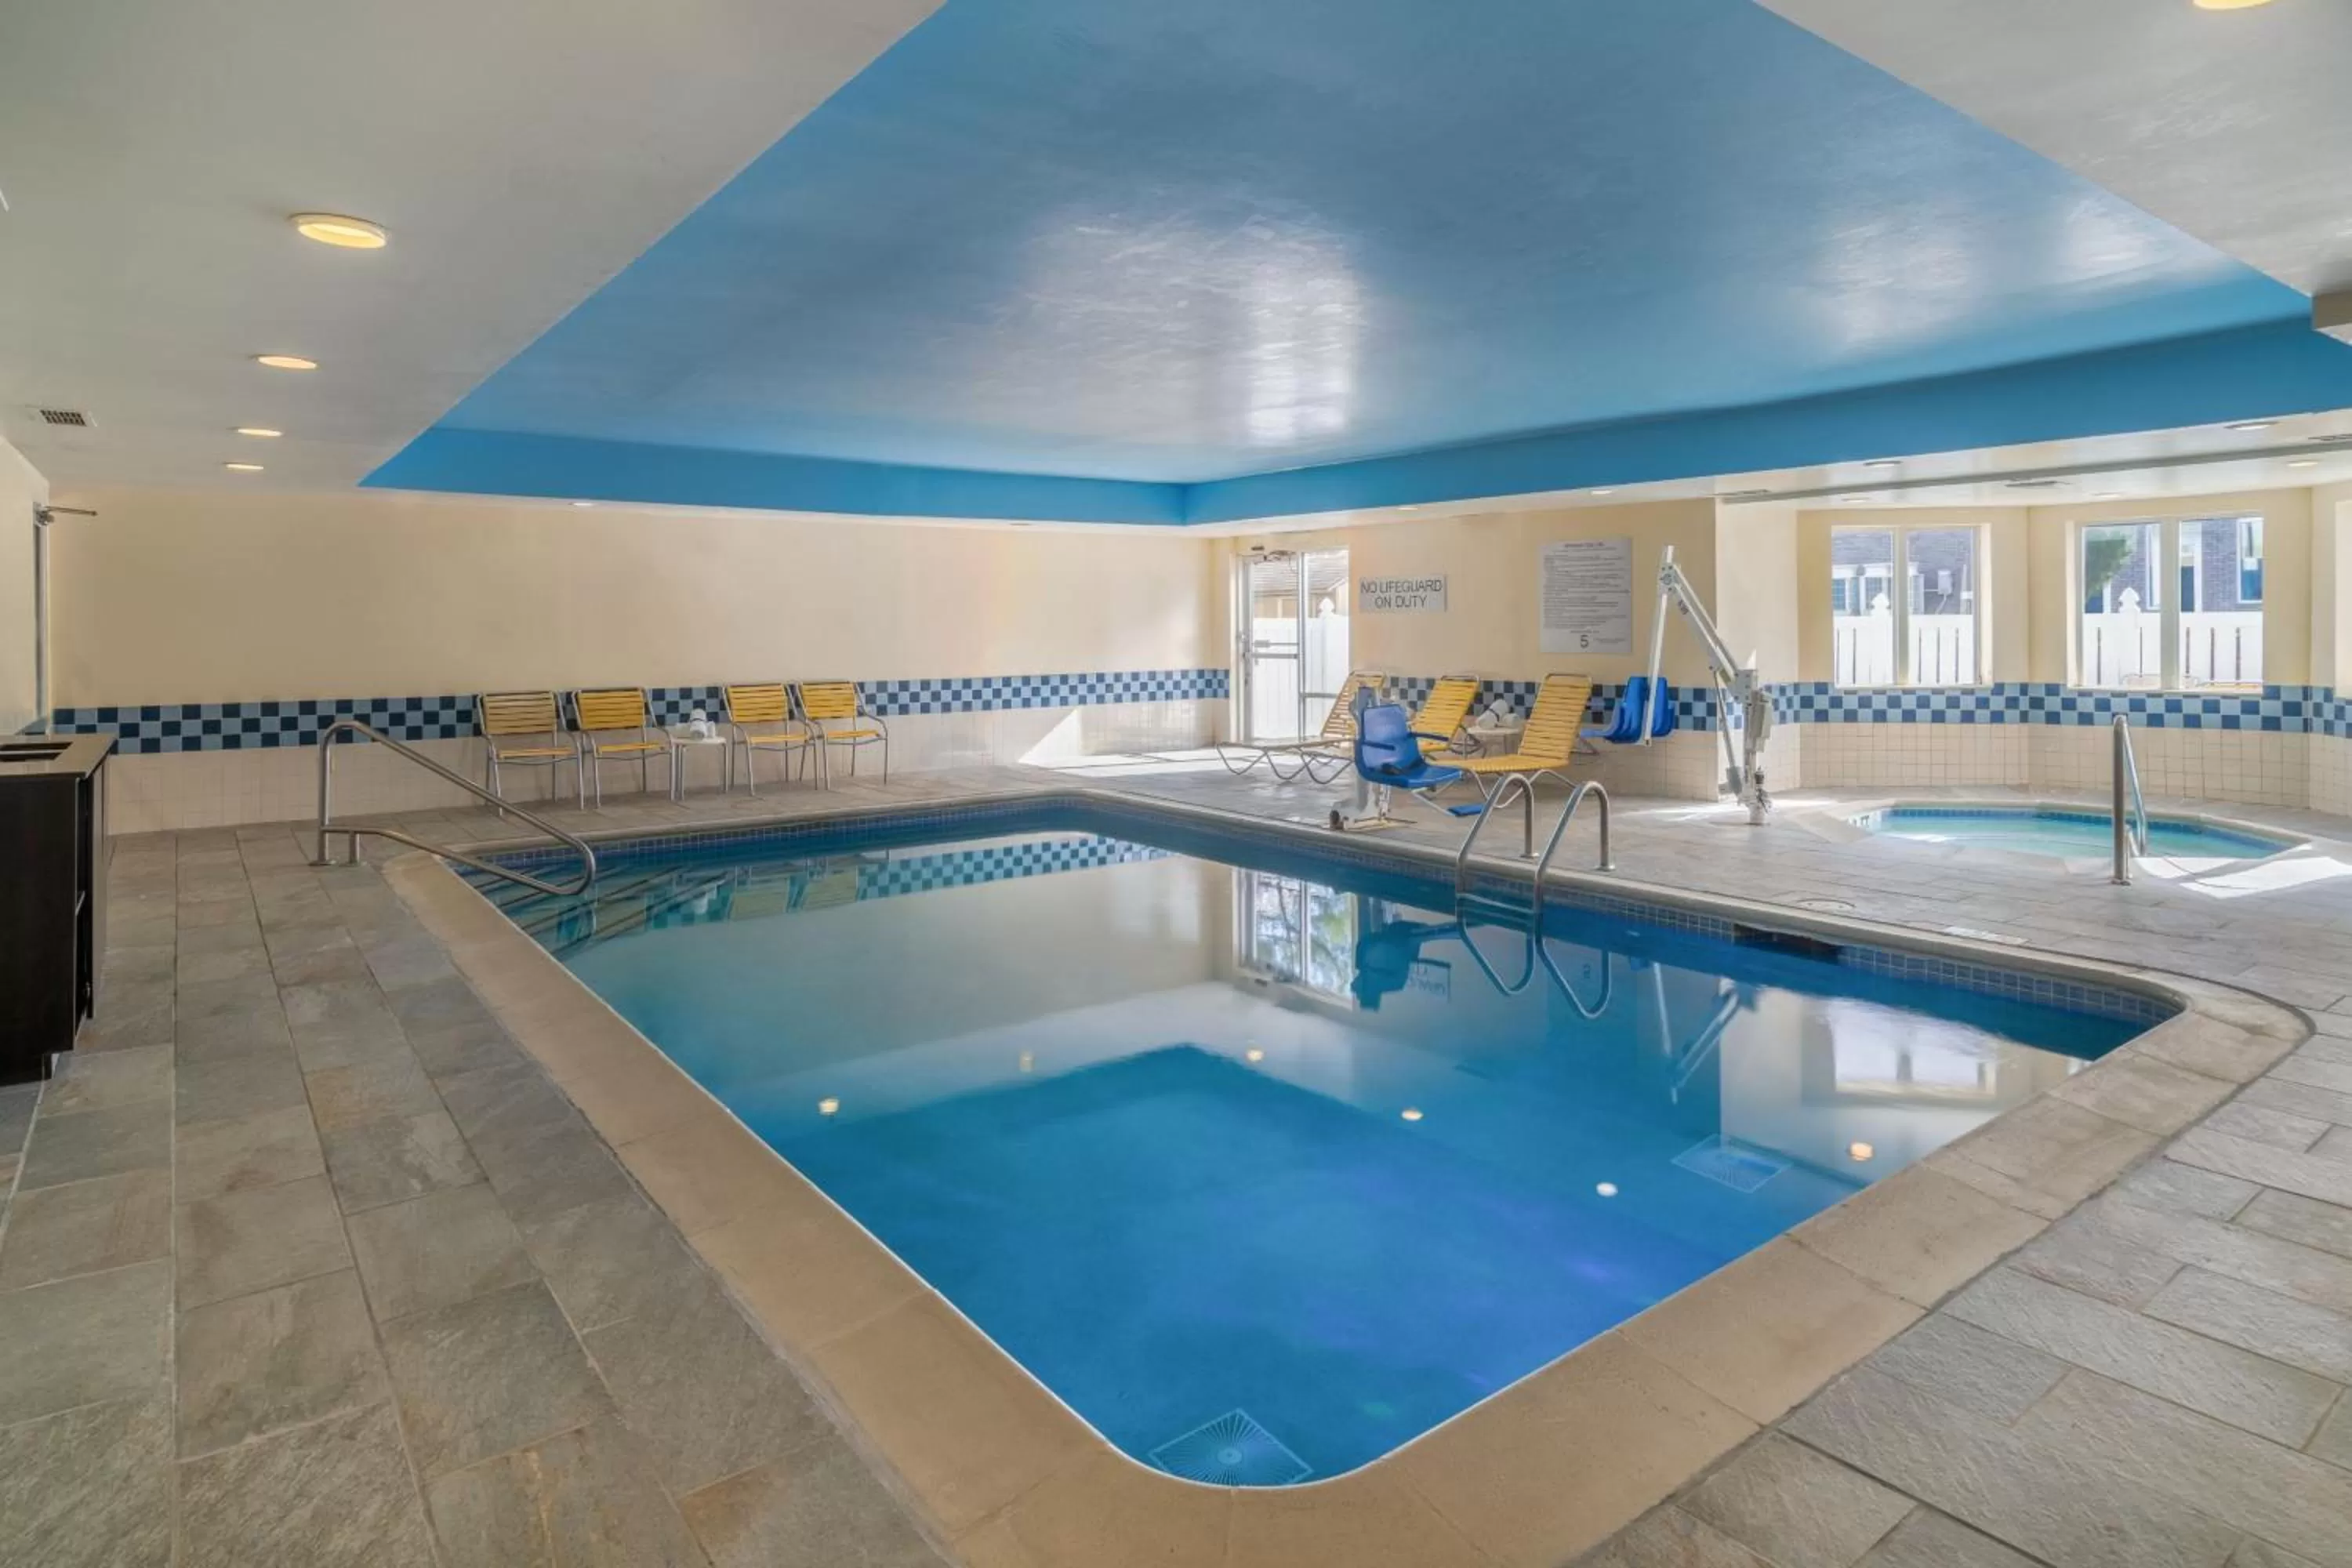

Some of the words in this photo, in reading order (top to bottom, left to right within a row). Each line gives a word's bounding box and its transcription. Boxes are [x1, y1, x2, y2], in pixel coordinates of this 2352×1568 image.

[1360, 581, 1377, 593] NO
[1379, 579, 1443, 593] LIFEGUARD
[1374, 596, 1392, 609] ON
[1395, 595, 1428, 609] DUTY
[1580, 634, 1589, 649] 5
